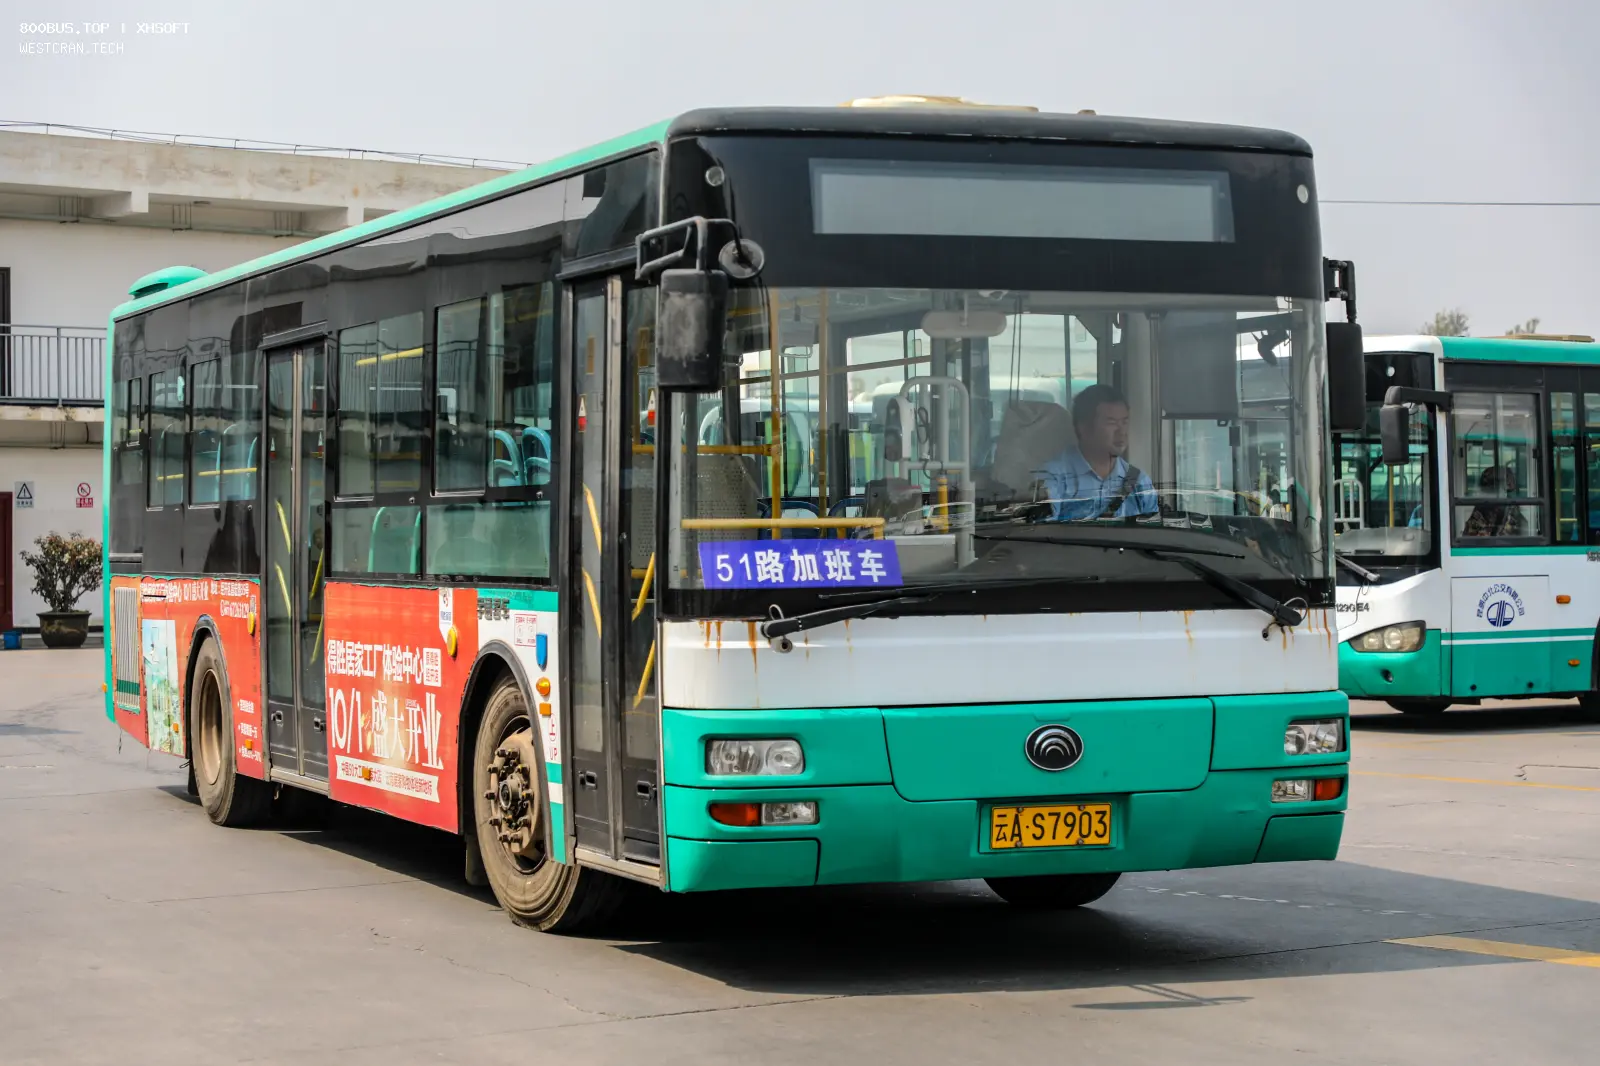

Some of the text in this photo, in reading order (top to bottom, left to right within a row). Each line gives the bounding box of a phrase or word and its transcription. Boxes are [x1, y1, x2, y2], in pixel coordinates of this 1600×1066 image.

[716, 548, 887, 583] 51路加班车
[327, 639, 424, 685] 得胜居家工厂体验中心
[371, 689, 445, 770] 盛大开业
